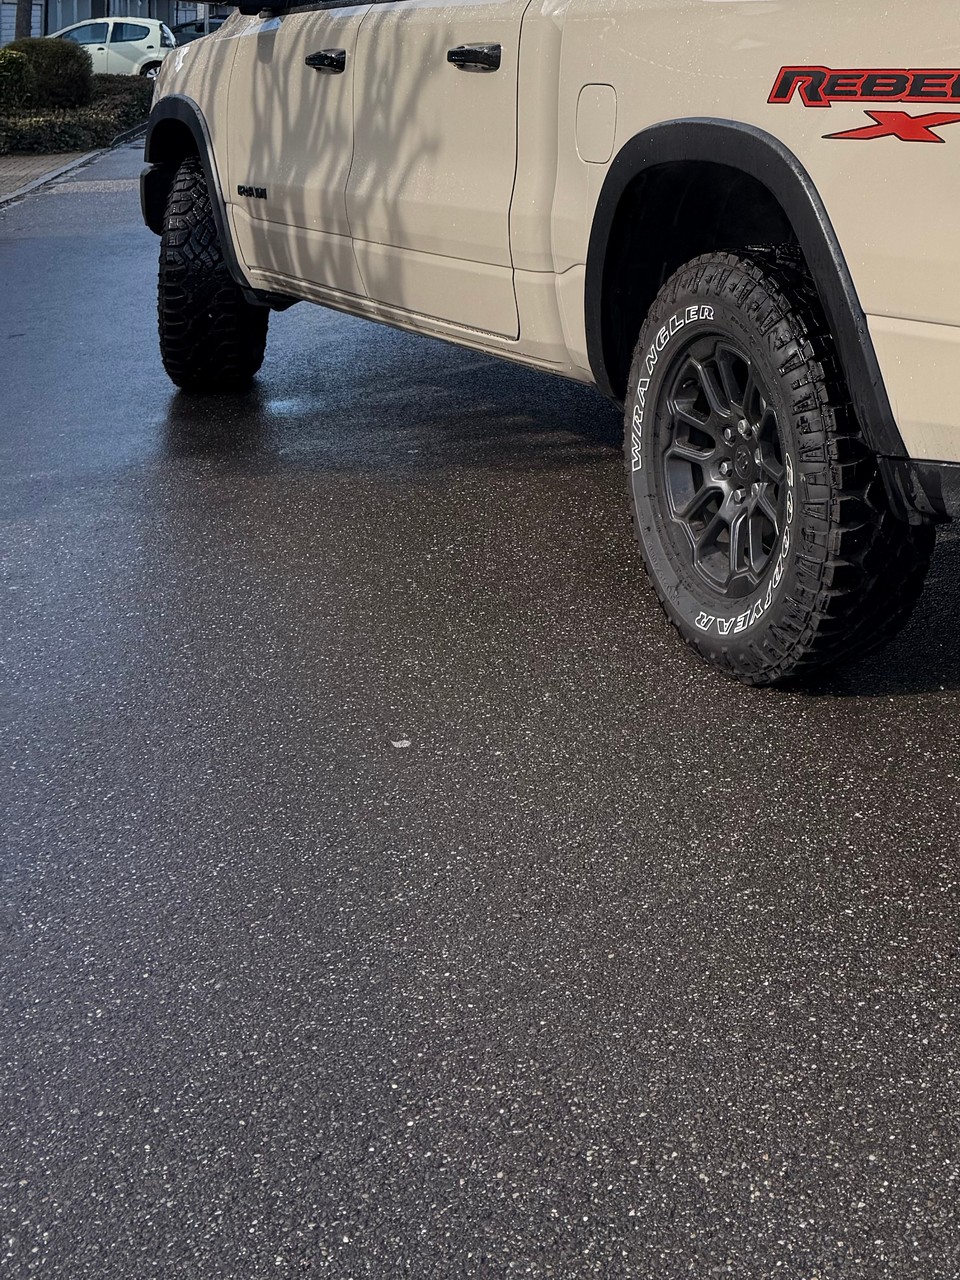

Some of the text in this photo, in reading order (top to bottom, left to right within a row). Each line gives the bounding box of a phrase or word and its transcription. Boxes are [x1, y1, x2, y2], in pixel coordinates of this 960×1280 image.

[237, 184, 267, 200] RAM
[631, 305, 715, 472] WRANGLER
[694, 452, 794, 635] GOODYEAR
